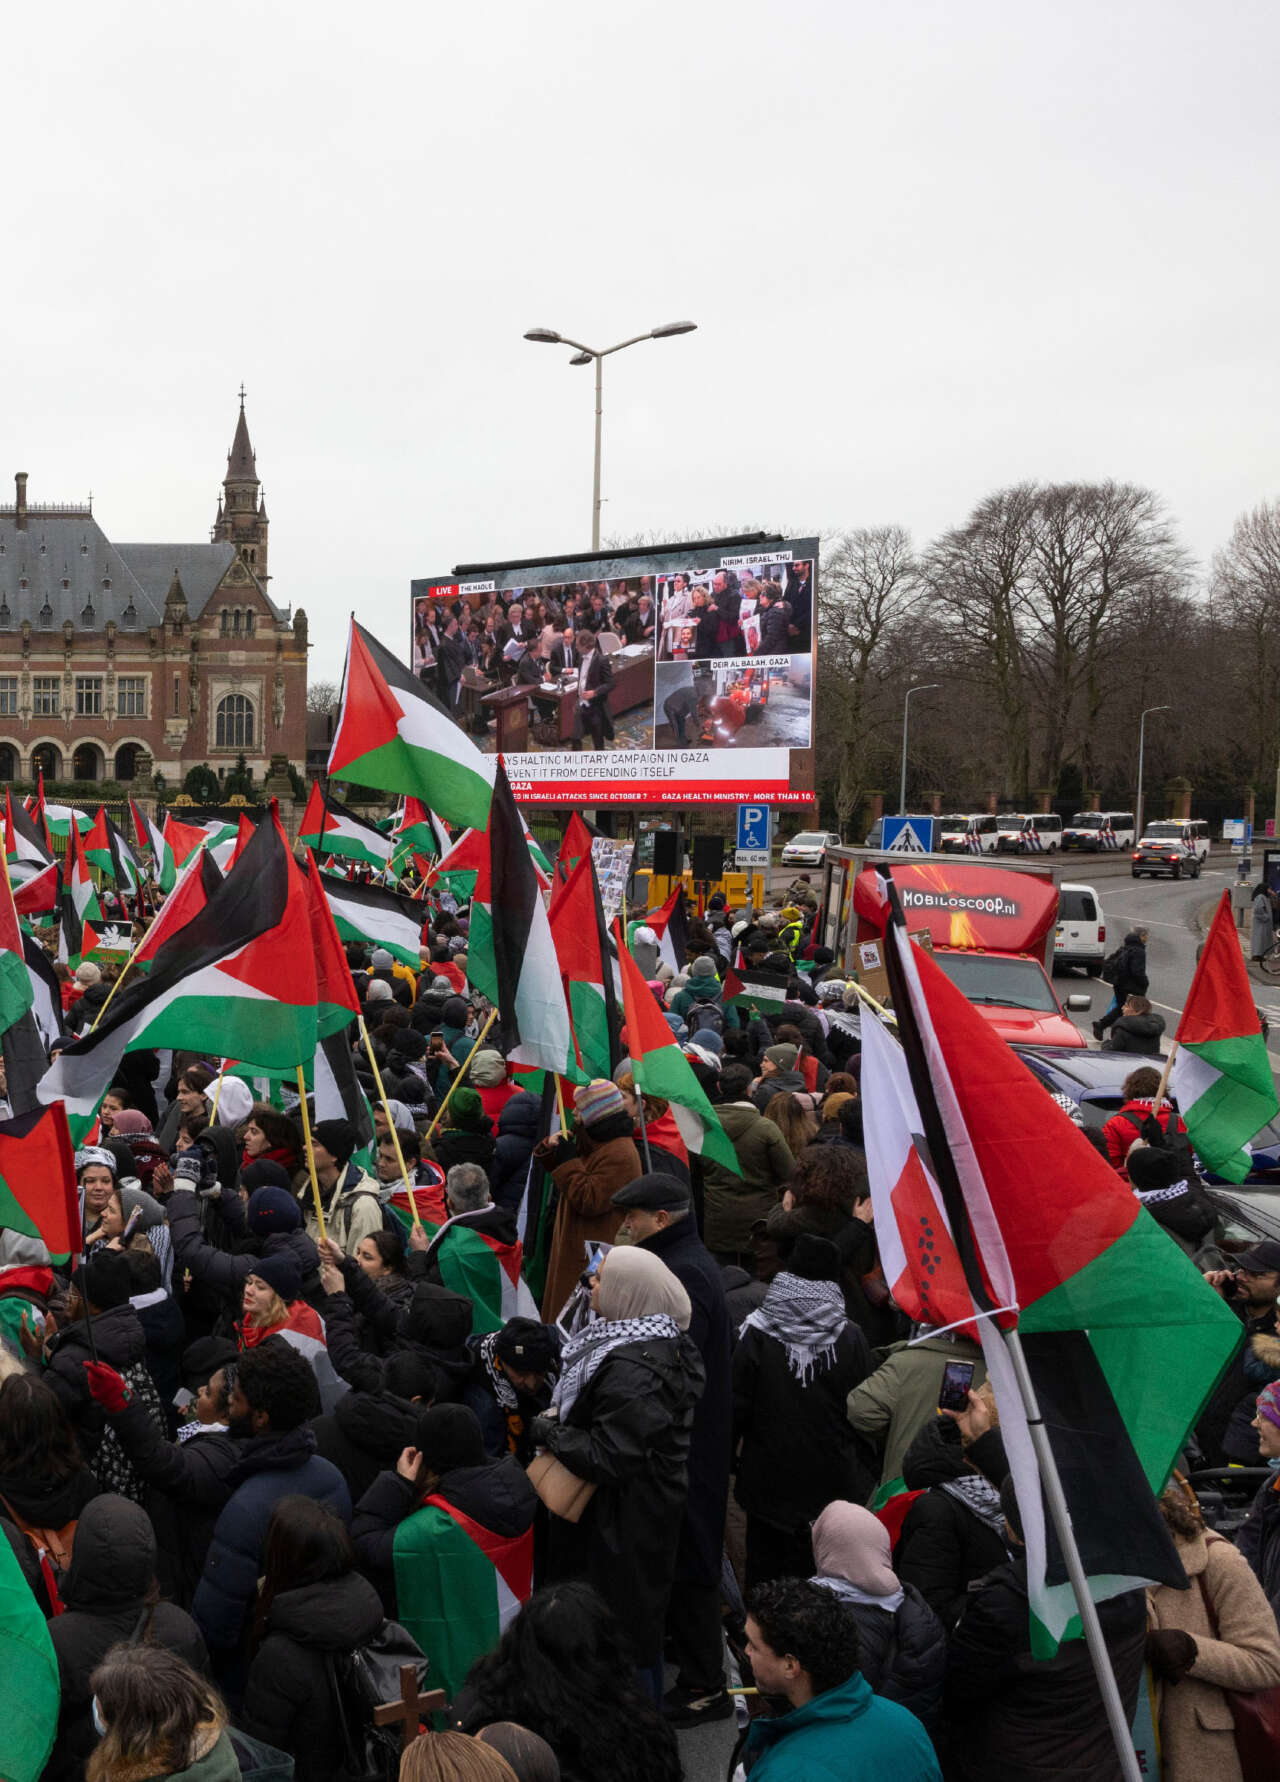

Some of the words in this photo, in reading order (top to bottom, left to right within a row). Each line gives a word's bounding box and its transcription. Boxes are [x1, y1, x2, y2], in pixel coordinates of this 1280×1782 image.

[436, 586, 452, 595] LIVE
[712, 661, 729, 669] DEIR
[494, 755, 519, 766] SYS
[520, 755, 561, 766] HALTING
[563, 754, 608, 765] MILITARY
[611, 753, 664, 764] CAMPAIGN
[667, 753, 678, 763] IN
[680, 752, 710, 763] GAZA
[539, 769, 548, 779] IT
[550, 768, 578, 778] FROM
[580, 767, 637, 778] DEFENDING
[640, 766, 675, 777] ITSELF
[510, 782, 533, 791] GAZA
[744, 808, 763, 830] P
